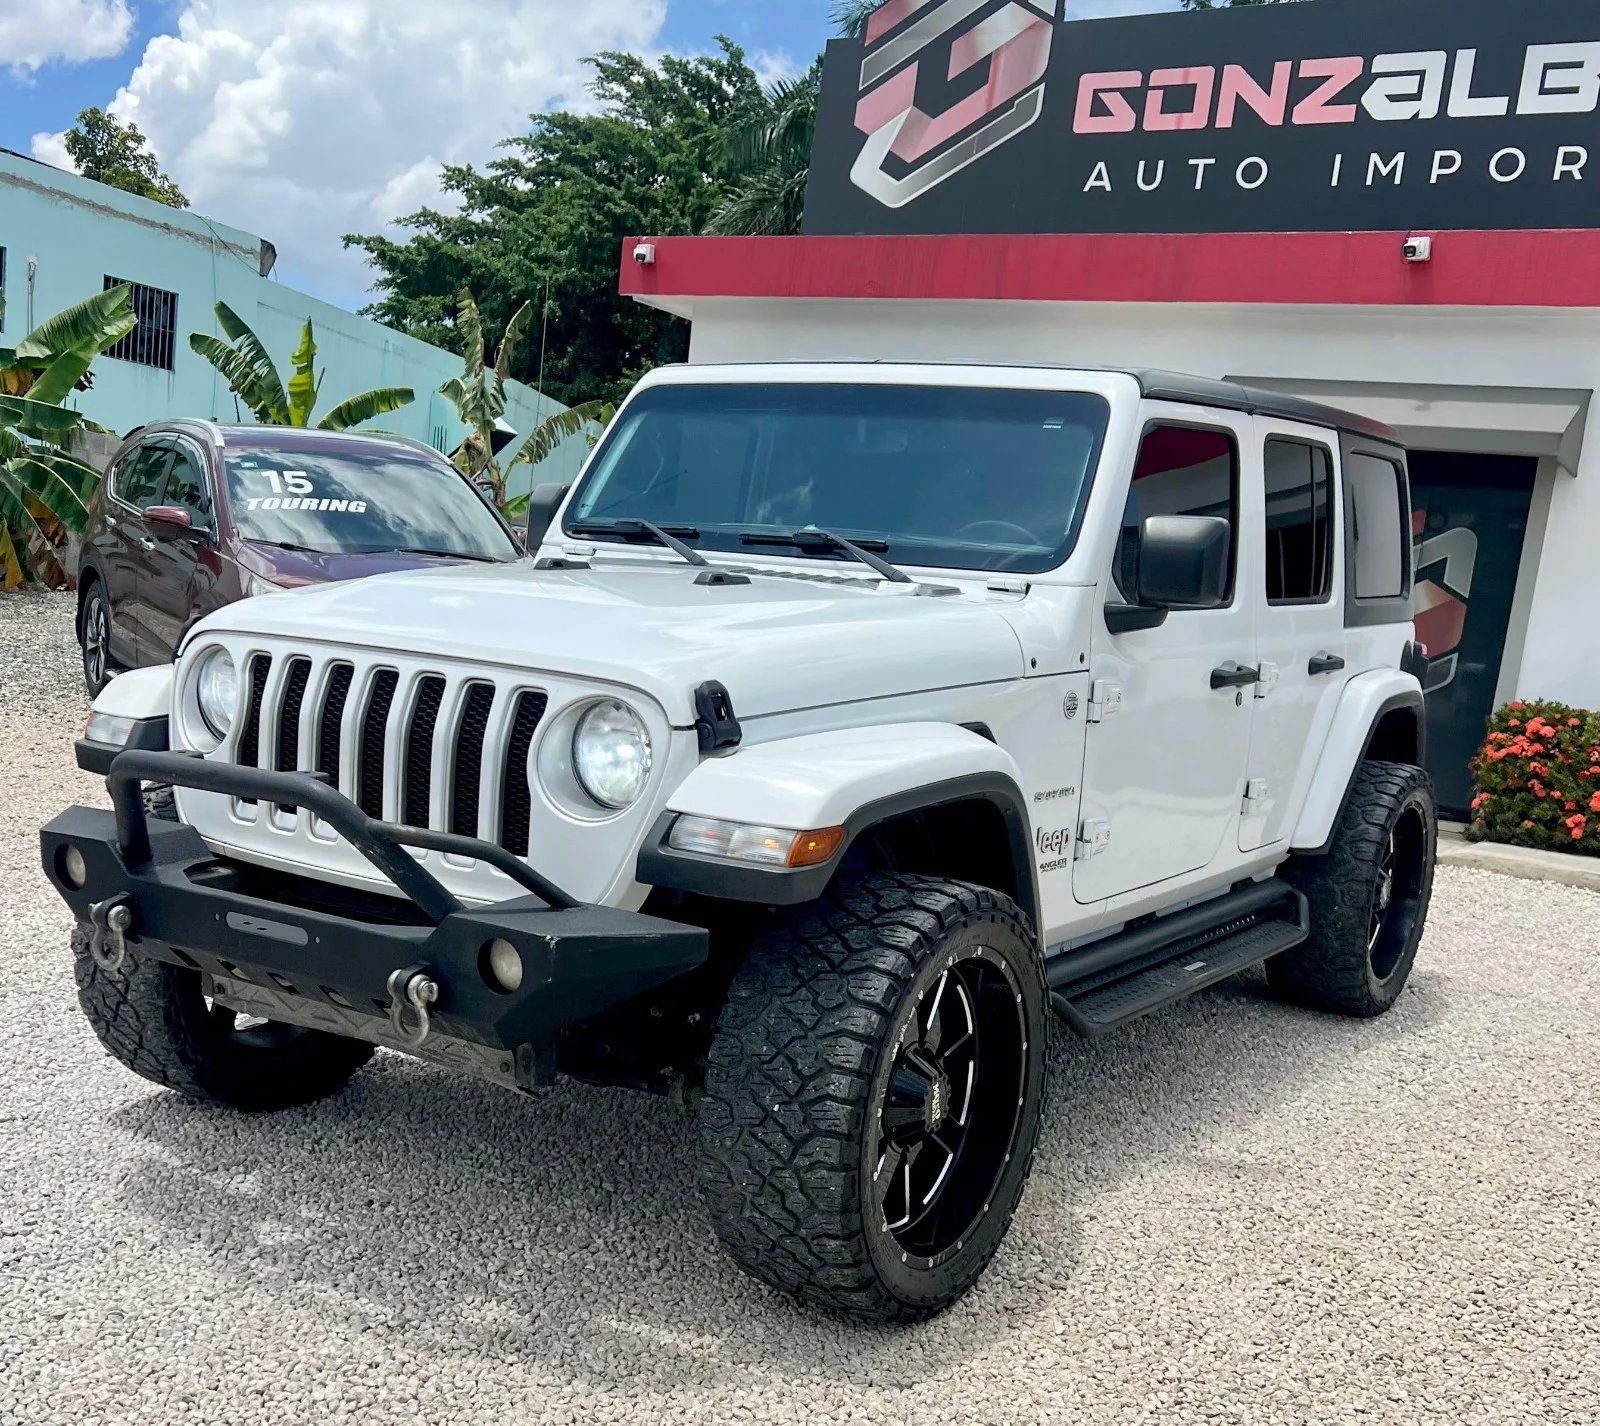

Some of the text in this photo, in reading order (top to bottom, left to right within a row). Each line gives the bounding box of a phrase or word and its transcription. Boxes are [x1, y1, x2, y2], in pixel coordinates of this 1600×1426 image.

[1082, 145, 1588, 192] AUTO IMPOR
[260, 470, 314, 494] 15
[246, 497, 367, 513] TOURING
